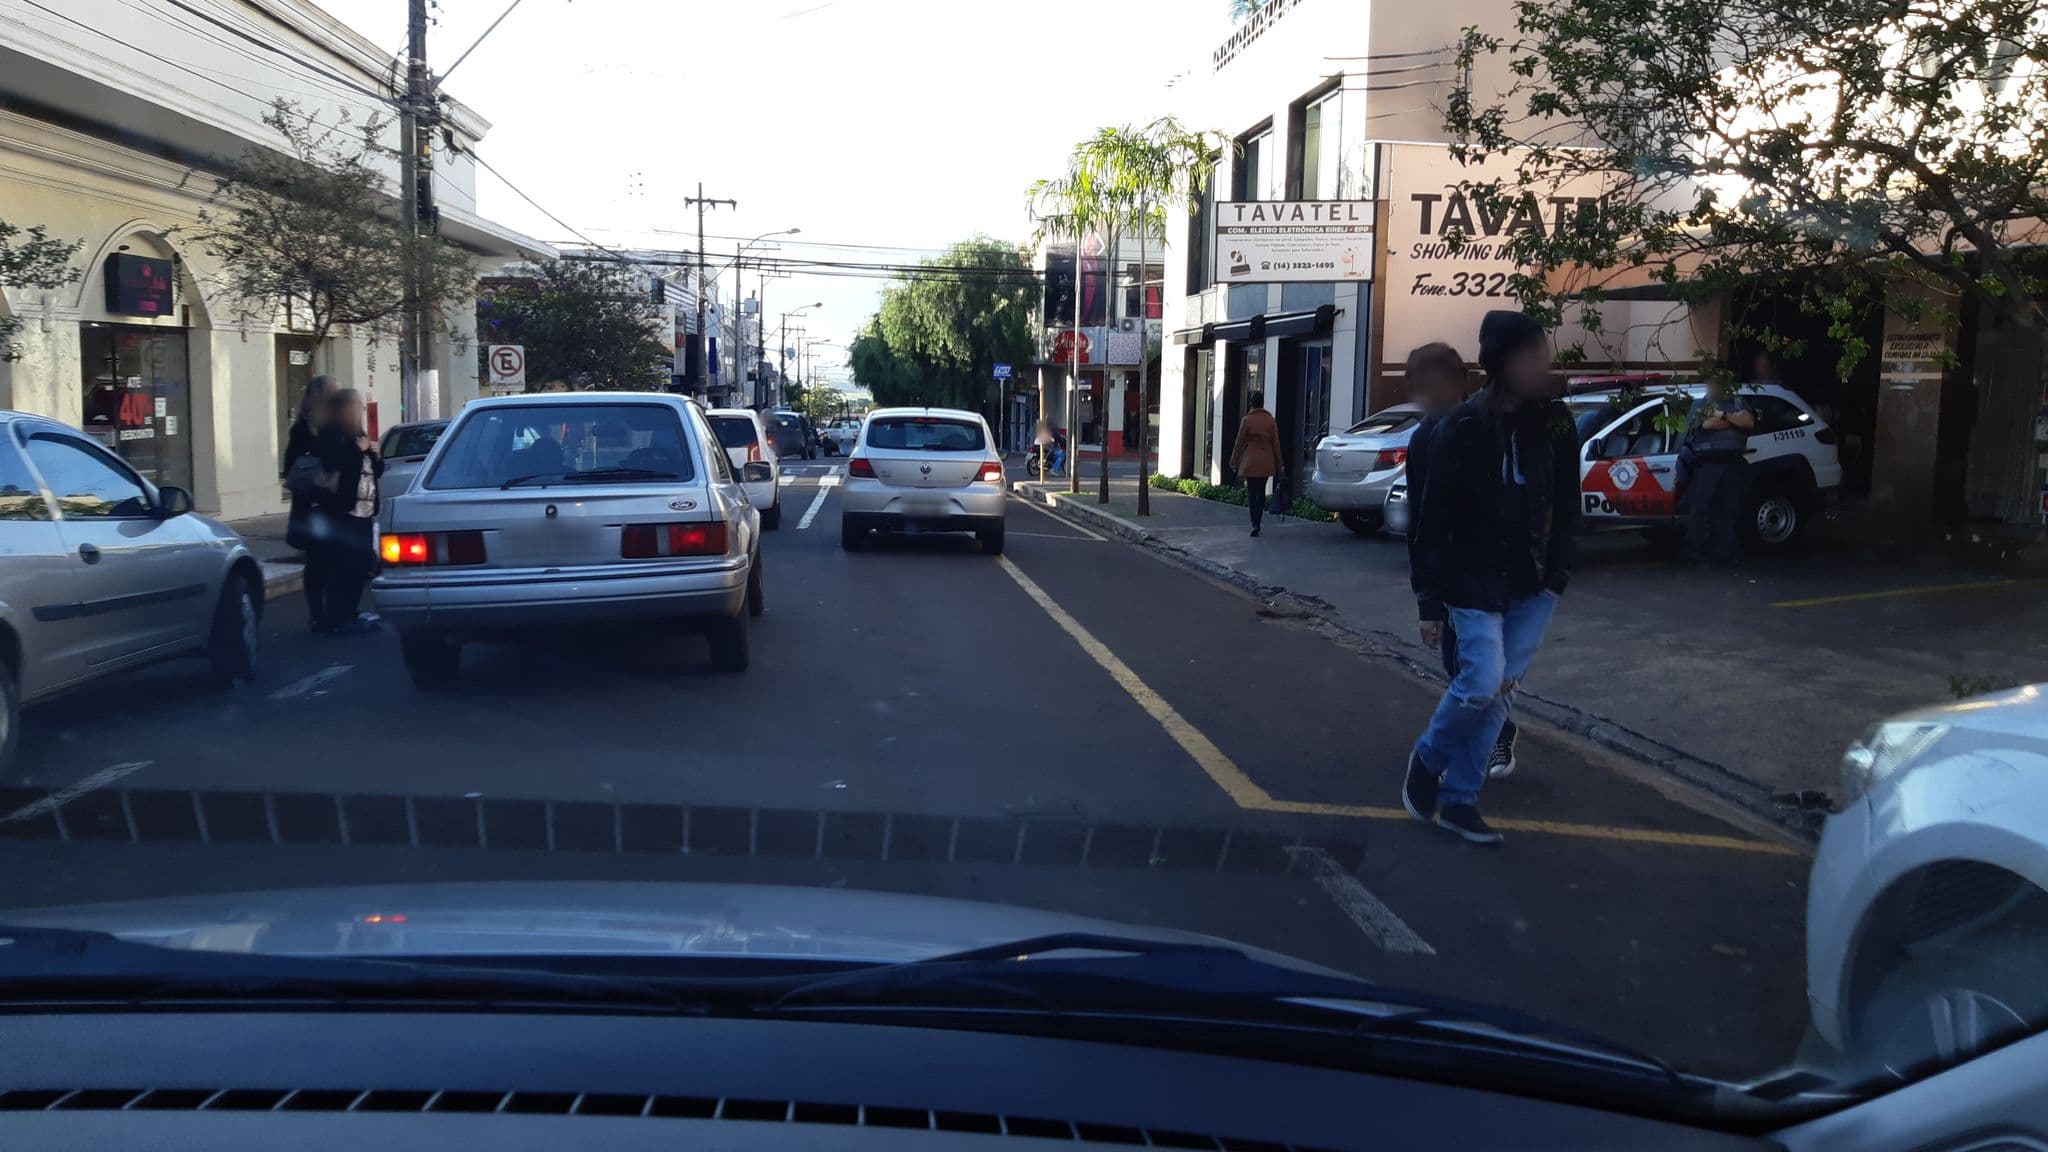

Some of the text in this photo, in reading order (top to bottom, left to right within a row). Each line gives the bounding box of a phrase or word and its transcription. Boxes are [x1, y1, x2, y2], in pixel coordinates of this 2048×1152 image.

[1234, 203, 1359, 222] TAVATEL
[1411, 192, 1608, 238] TAVAT
[1410, 243, 1492, 260] SHOPPING
[1273, 261, 1290, 270] (14)
[120, 428, 155, 440] DESCONTO
